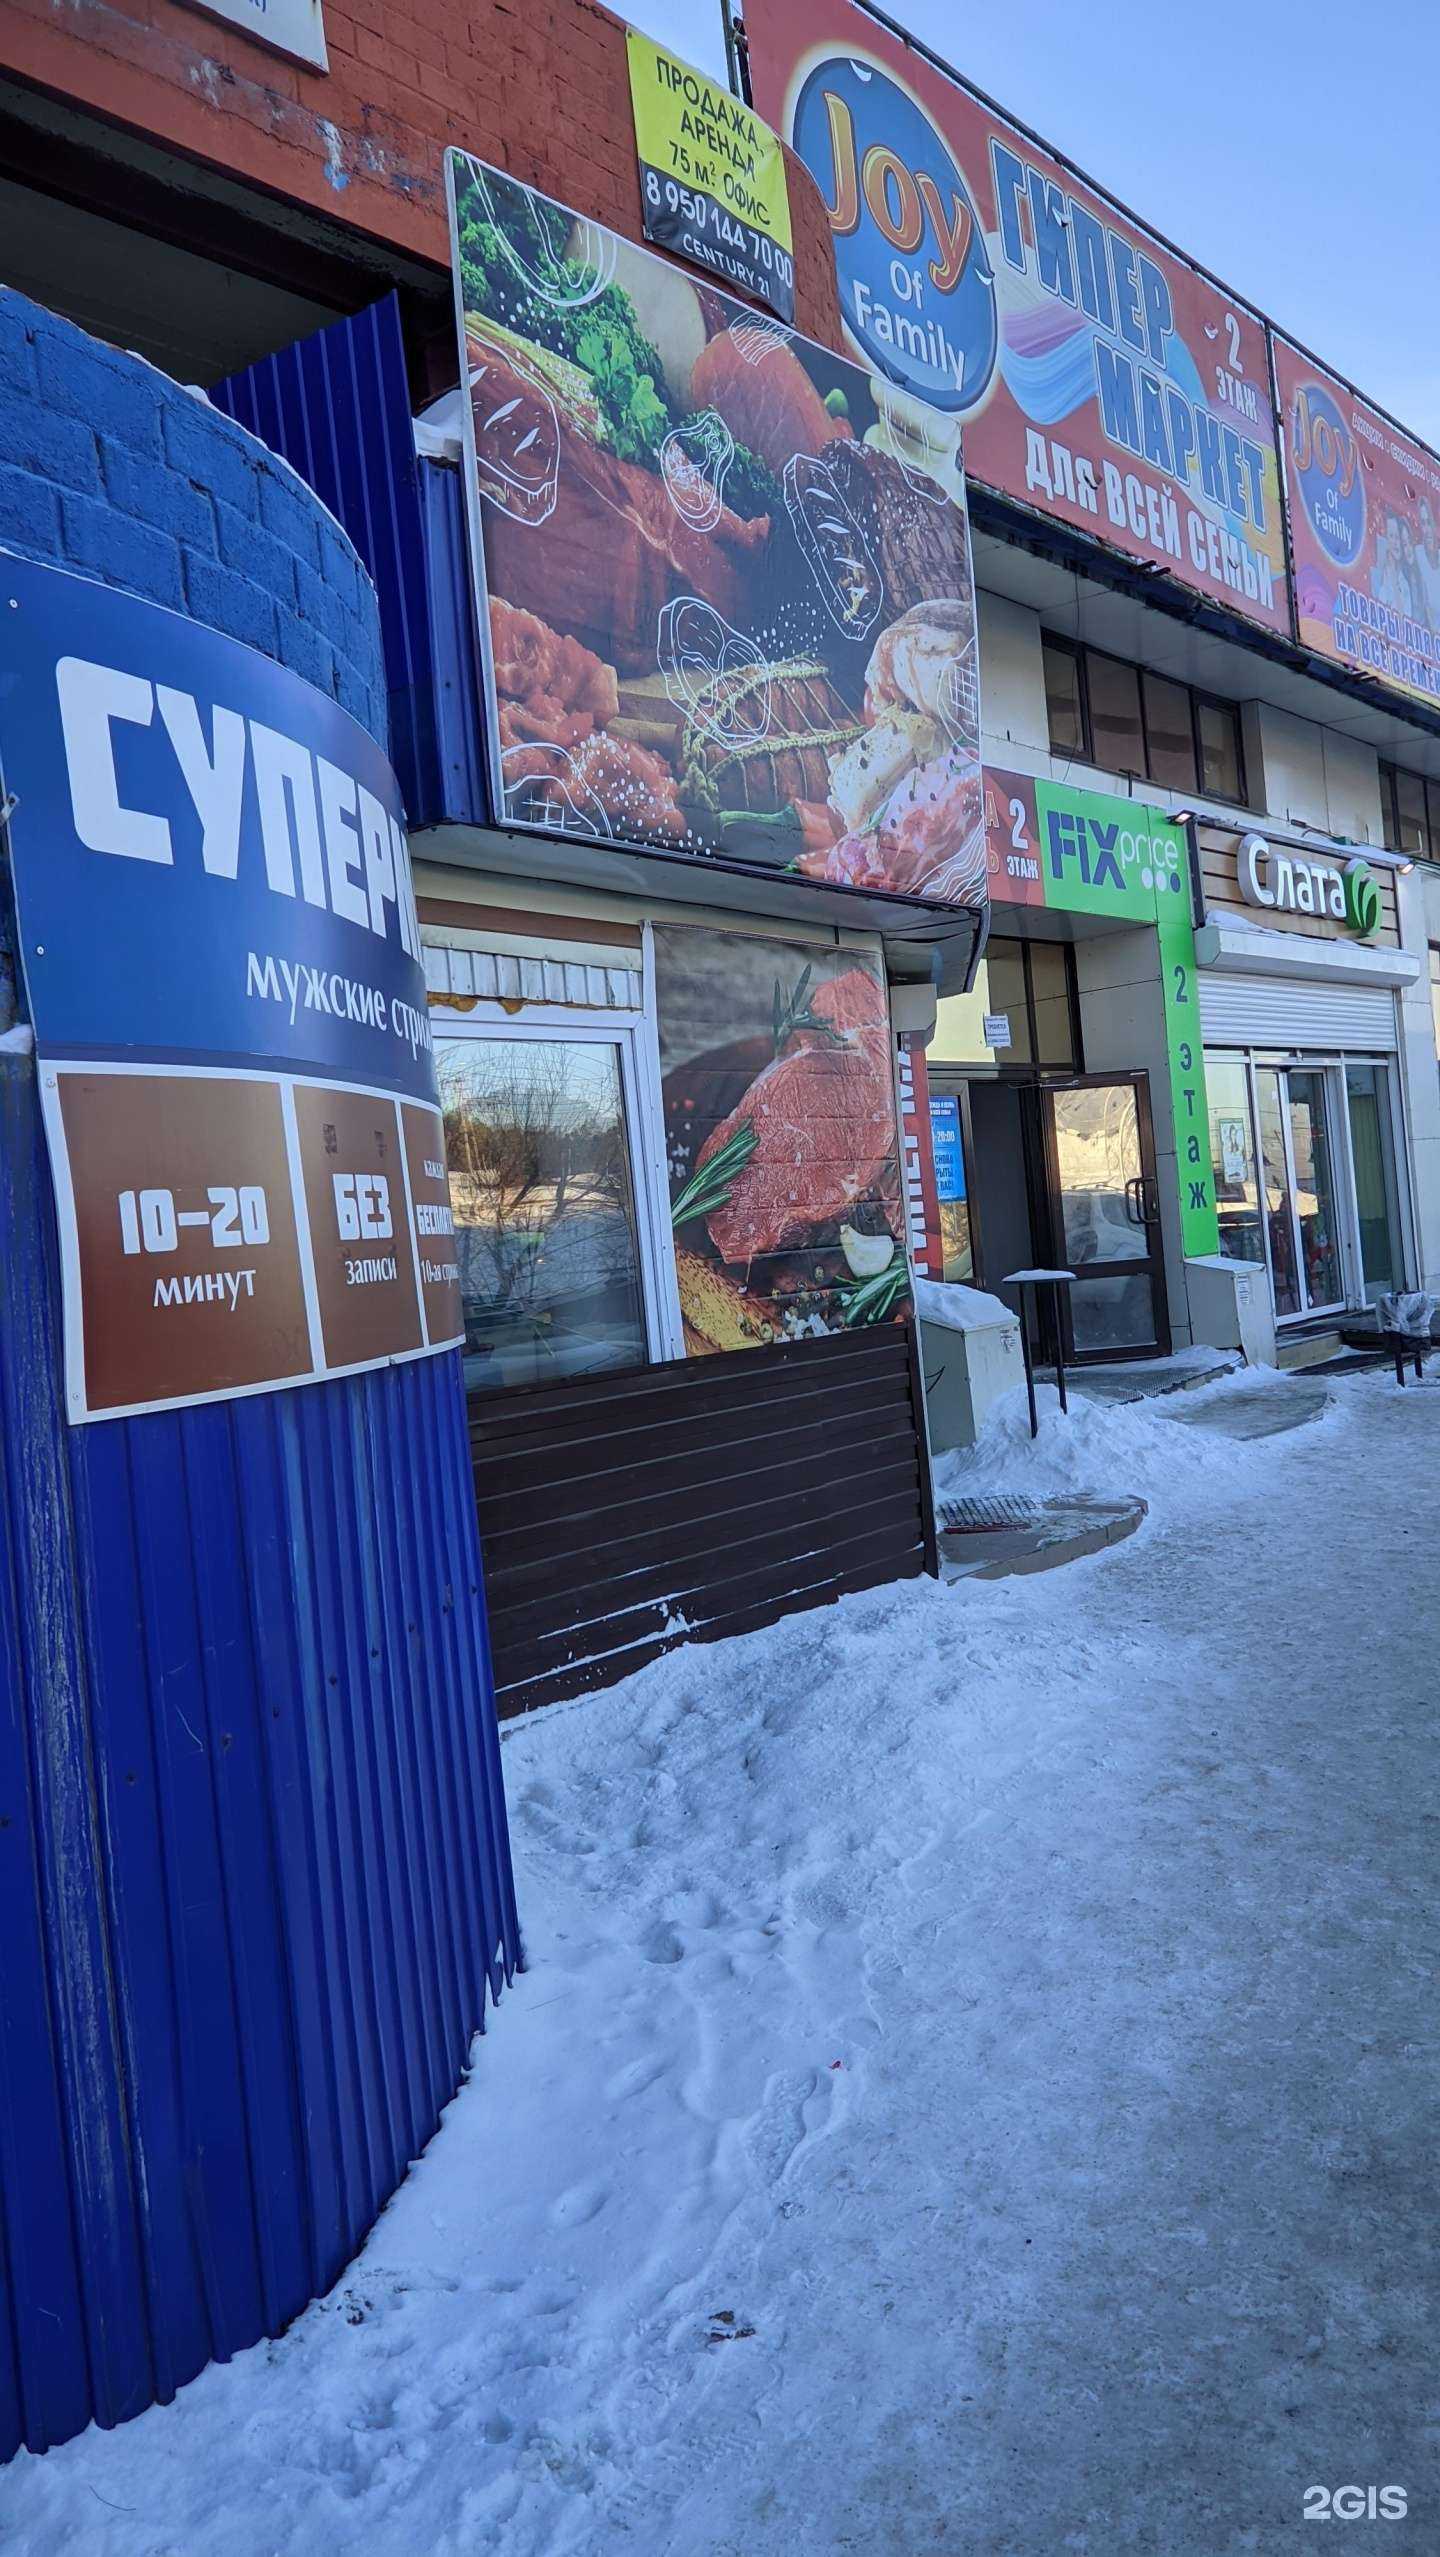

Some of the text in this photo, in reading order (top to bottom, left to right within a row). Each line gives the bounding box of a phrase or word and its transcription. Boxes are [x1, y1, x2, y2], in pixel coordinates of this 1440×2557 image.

[681, 109, 756, 182] АРЕНДА
[669, 140, 691, 174] 75
[723, 172, 771, 226] ОФИС
[646, 171, 794, 289] 8 950 144 70 00
[990, 136, 1174, 370] ГИПЕР
[682, 233, 771, 299] CENTURY 21
[889, 260, 925, 310] Of
[852, 280, 968, 392] Family
[1225, 312, 1243, 374] 2
[1215, 365, 1258, 424] ЭТАЖ
[1093, 335, 1267, 535] МАРКЕТ
[1025, 427, 1275, 611] ДЛЯ ВСЕЙ СЕМЬИ
[1314, 501, 1353, 550] Family
[1326, 488, 1340, 512] Of
[1333, 617, 1358, 658] НА
[1337, 582, 1401, 643] ТОВАРЫ
[1009, 798, 1029, 850] 2
[1006, 855, 1039, 880] ЭТАЖ
[1240, 834, 1347, 918] Слата
[247, 951, 388, 1026] мужские
[1174, 964, 1189, 1004] 2
[332, 1172, 394, 1242] БЕЗ
[153, 1269, 257, 1312] минут
[344, 1256, 399, 1286] записи
